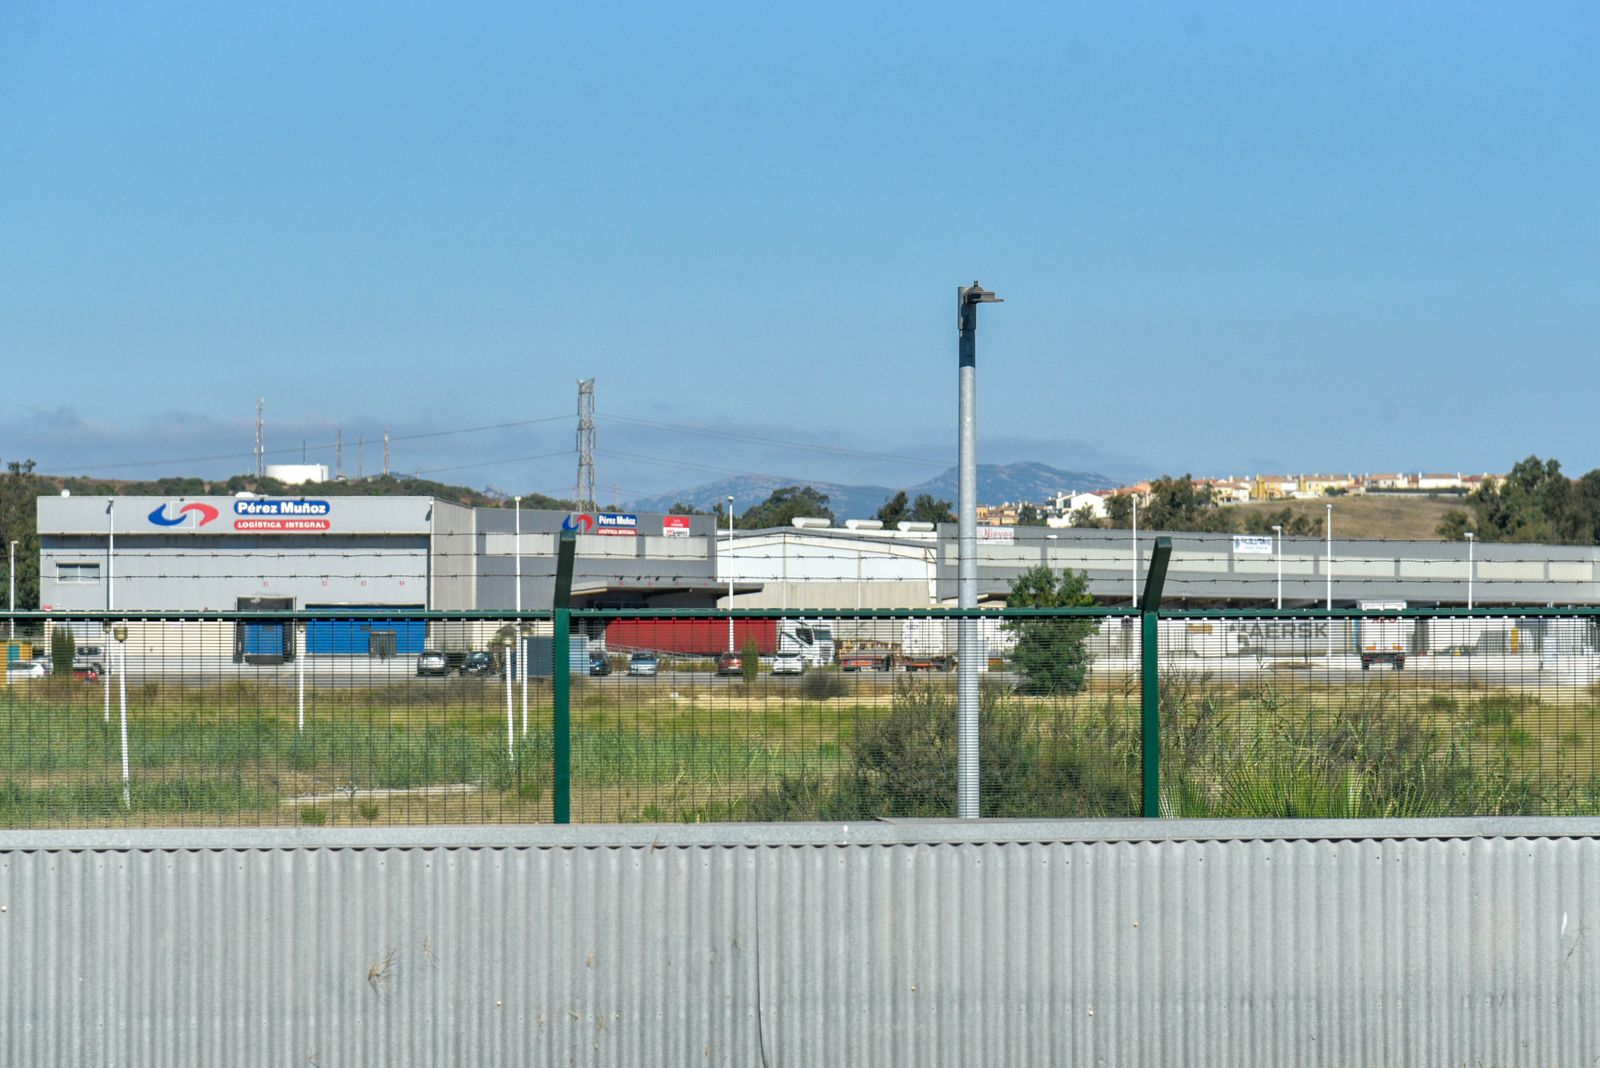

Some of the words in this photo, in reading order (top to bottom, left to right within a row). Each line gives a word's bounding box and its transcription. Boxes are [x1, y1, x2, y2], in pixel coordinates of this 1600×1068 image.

[238, 501, 277, 514] Pérez
[281, 501, 326, 514] Muñoz
[238, 520, 281, 528] LOGÍSTICA
[599, 515, 616, 525] Pérez
